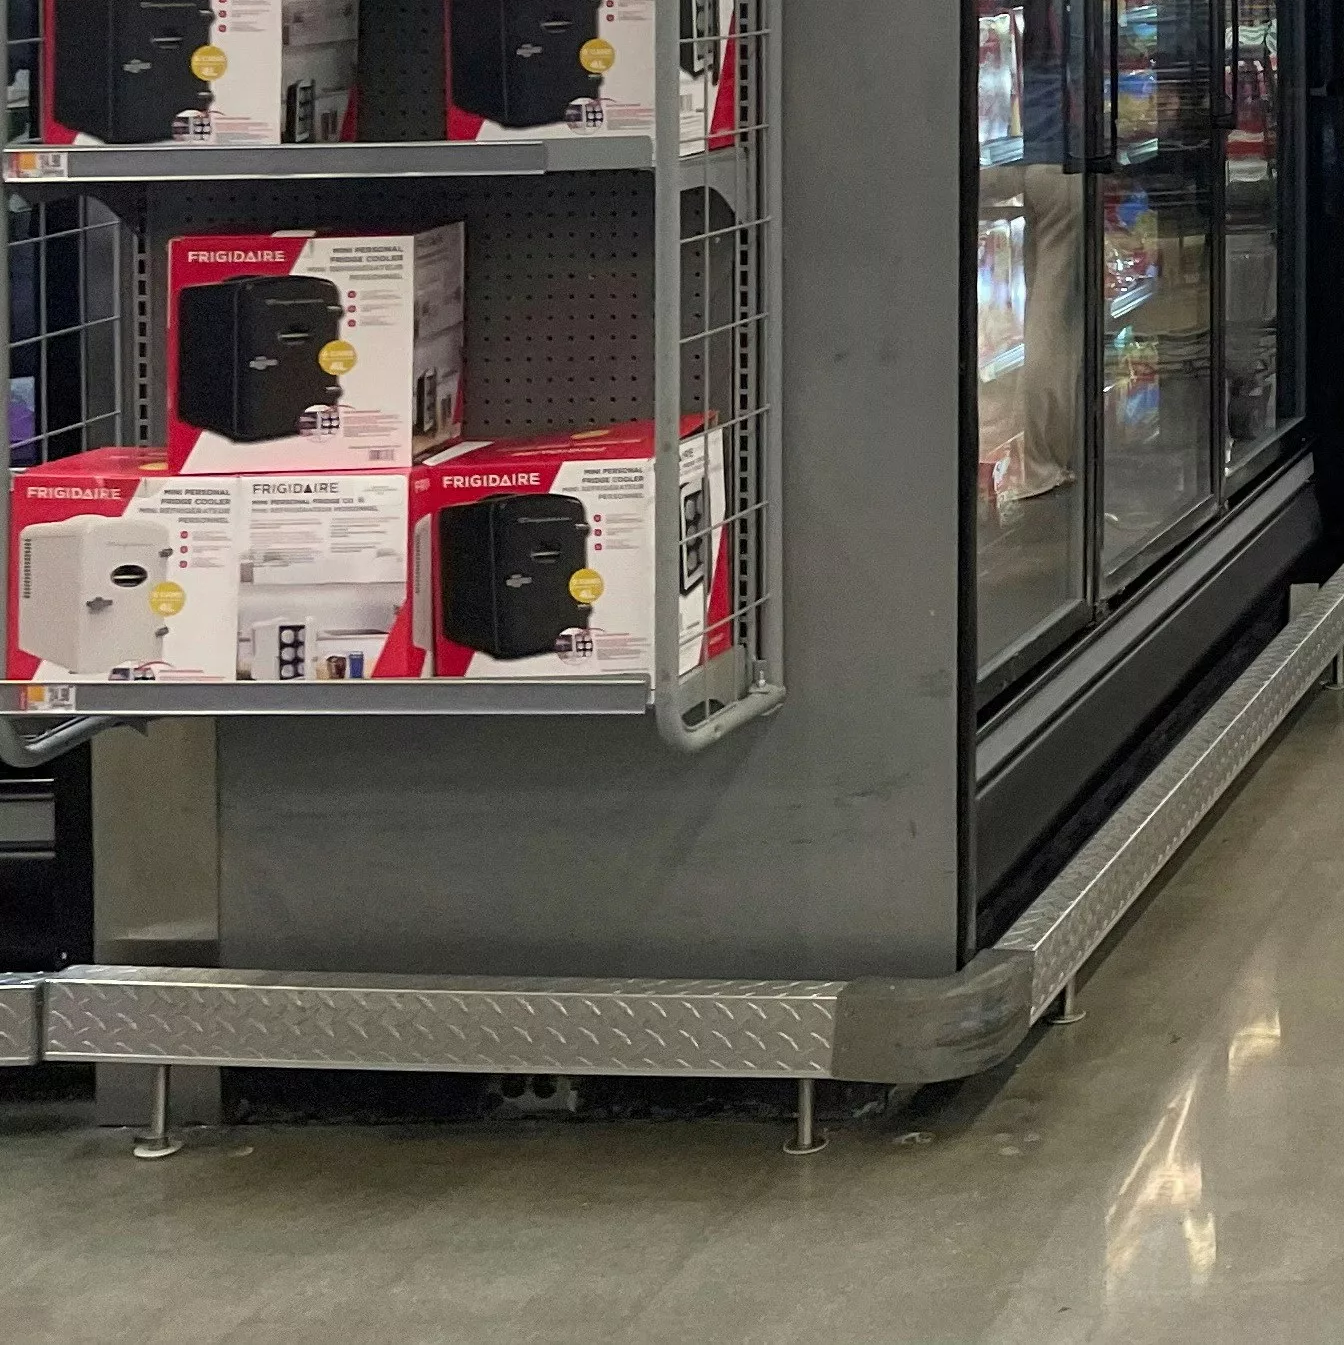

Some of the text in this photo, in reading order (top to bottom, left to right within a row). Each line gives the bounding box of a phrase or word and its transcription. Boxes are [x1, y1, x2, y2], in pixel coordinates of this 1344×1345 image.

[187, 250, 286, 263] FRIGIDAIRE
[442, 472, 541, 488] FRIGIDAIRE
[26, 486, 122, 500] FRIGIDAIRE
[252, 482, 339, 495] FRIGIDAIRE
